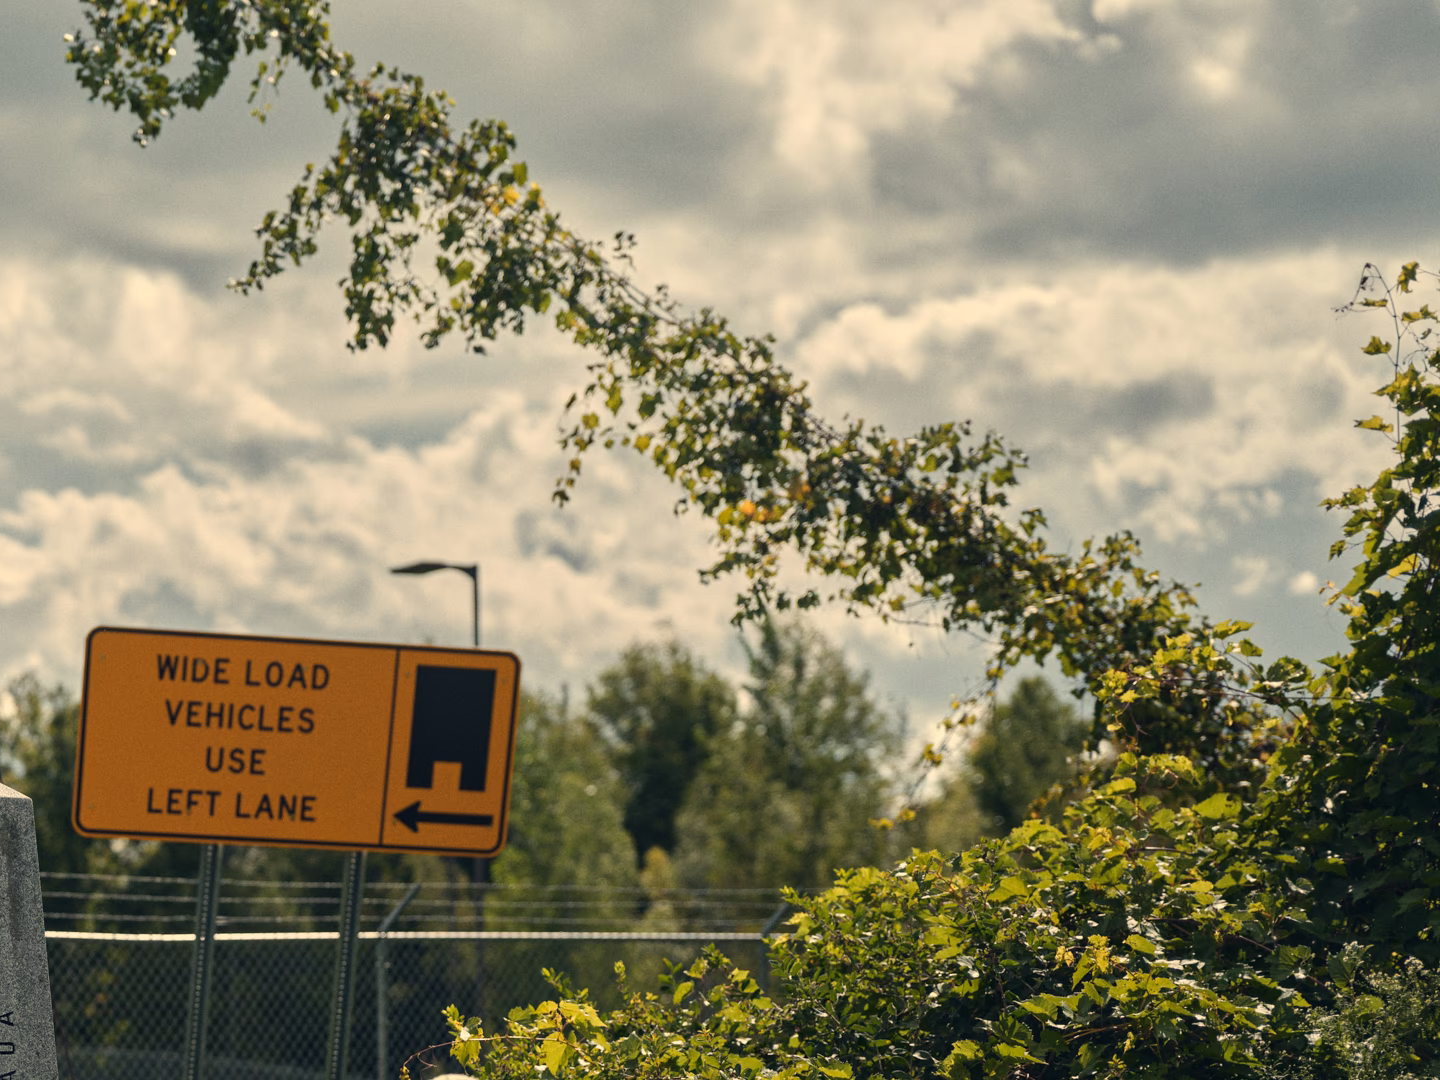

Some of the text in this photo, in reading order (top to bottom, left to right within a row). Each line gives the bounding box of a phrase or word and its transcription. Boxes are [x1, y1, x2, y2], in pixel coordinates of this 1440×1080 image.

[157, 653, 330, 690] WIDE LOAD
[166, 700, 315, 733] VEHICLES
[206, 746, 266, 775] USE
[147, 788, 317, 822] LEFT LANE
